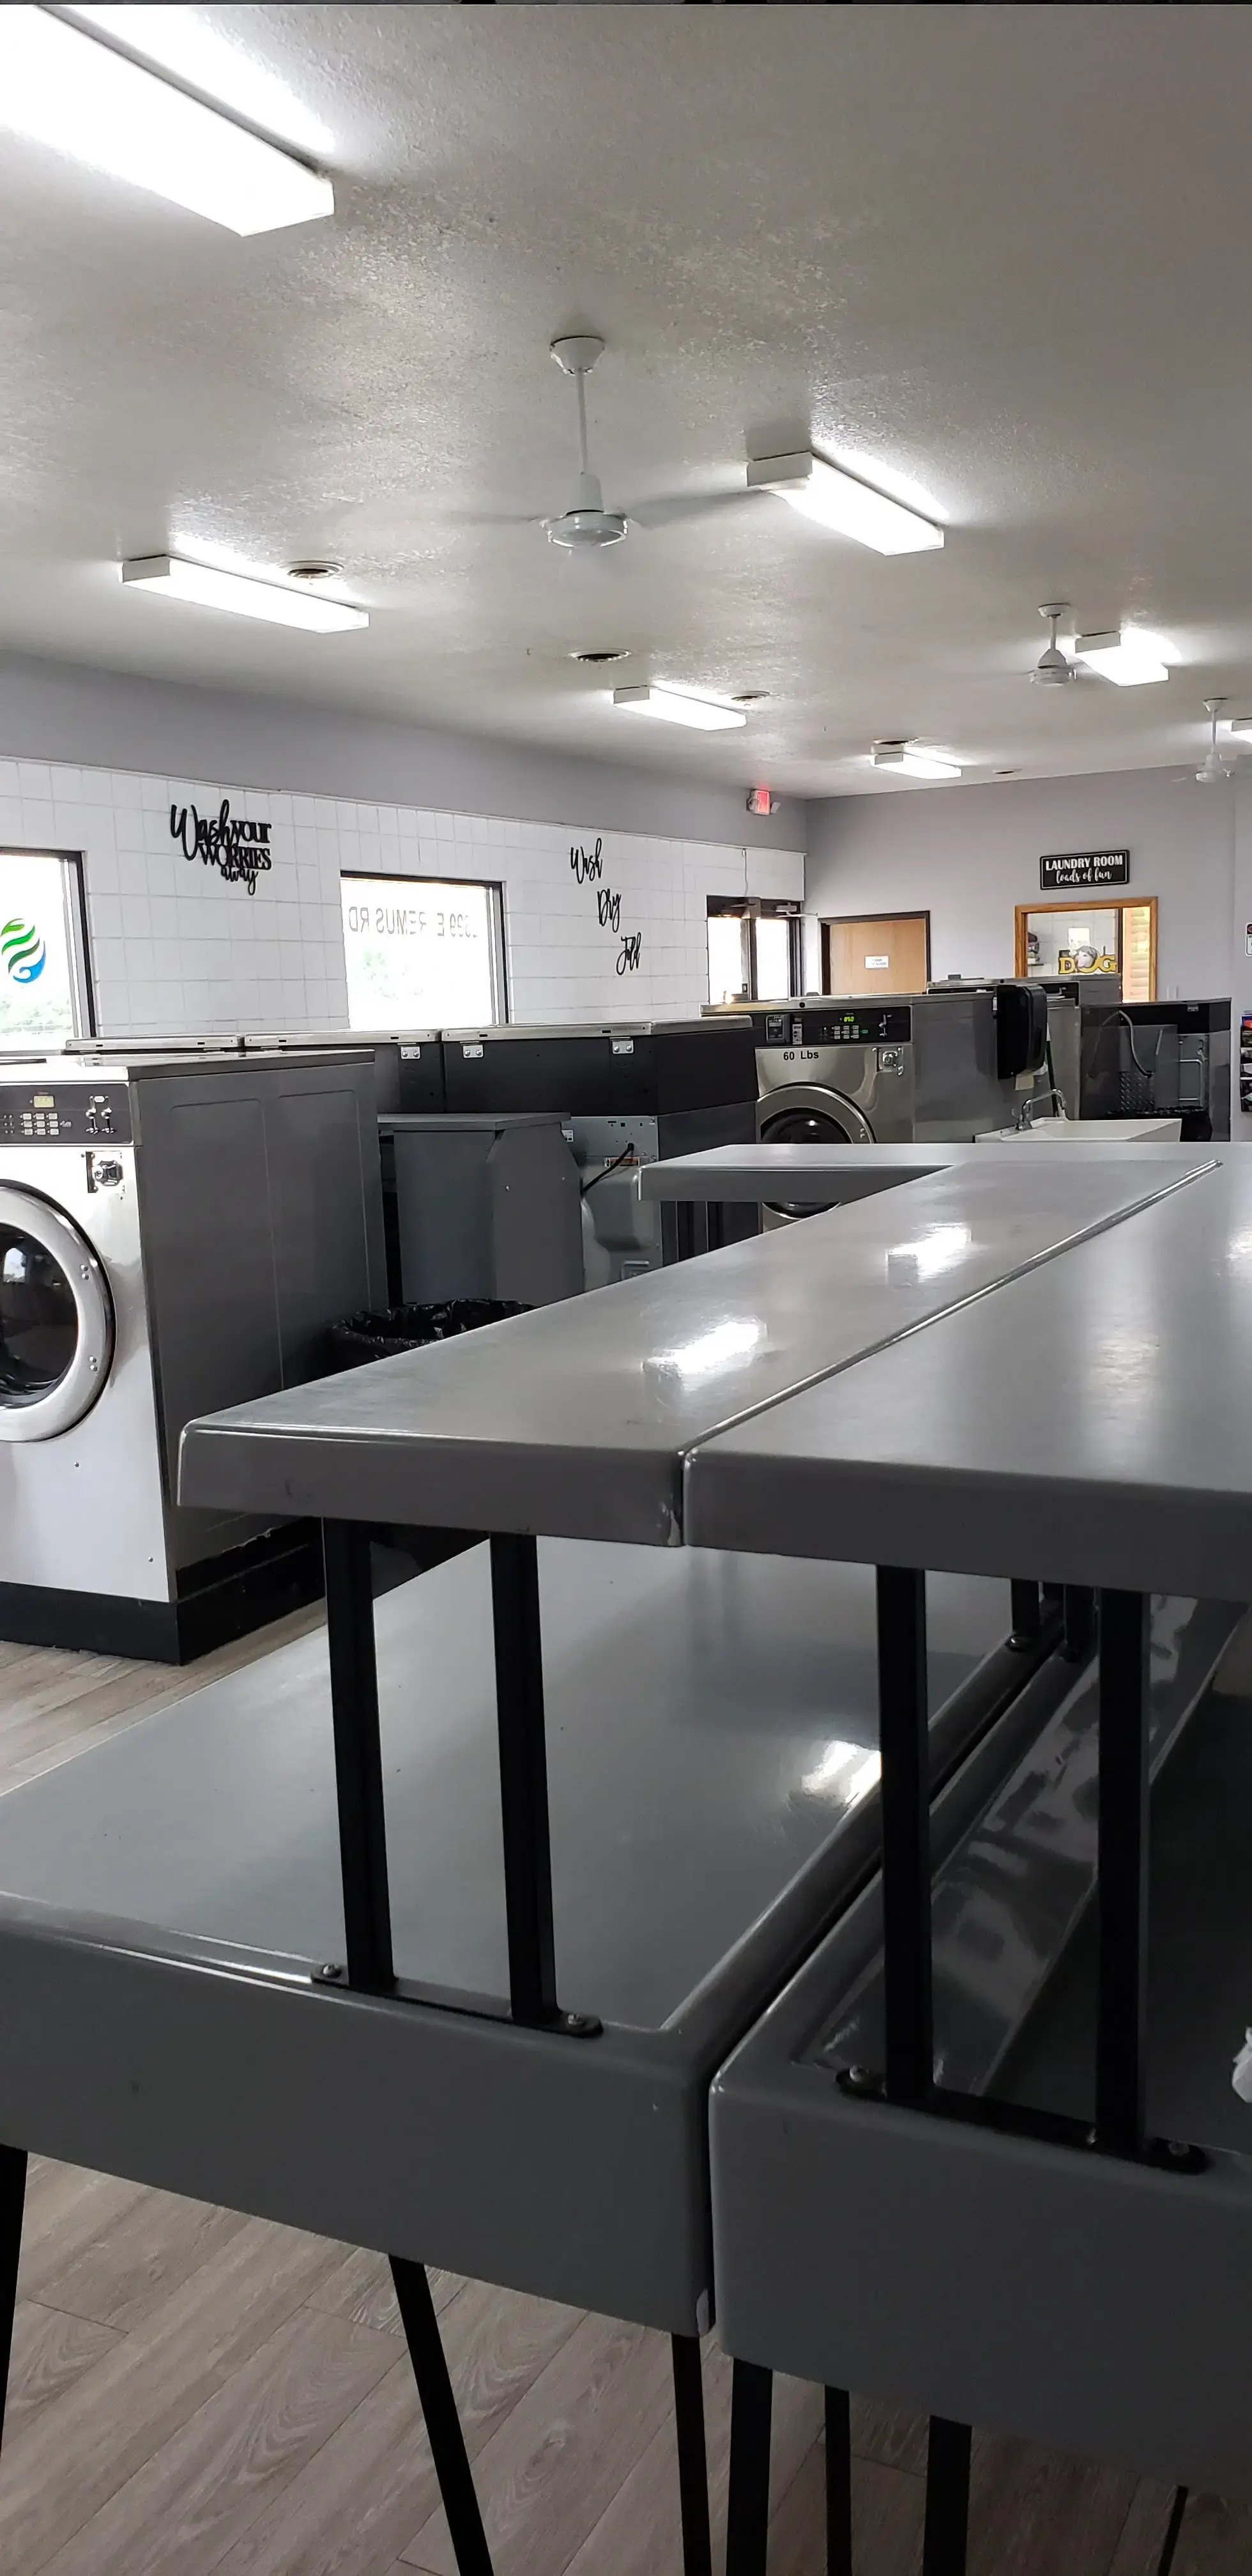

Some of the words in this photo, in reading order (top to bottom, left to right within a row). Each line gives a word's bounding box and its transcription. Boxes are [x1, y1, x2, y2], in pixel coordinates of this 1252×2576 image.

[170, 799, 231, 861] Wash
[197, 843, 272, 870] WORRIES
[570, 838, 603, 884] Wash
[1045, 857, 1091, 871] LAUNDRY
[1093, 854, 1124, 868] ROOM
[221, 866, 259, 896] away
[1056, 868, 1081, 884] loads
[1082, 867, 1093, 882] of
[1094, 866, 1112, 882] fun
[597, 888, 622, 933] Dry
[783, 1051, 795, 1061] 60
[800, 1050, 820, 1060] Lbs
